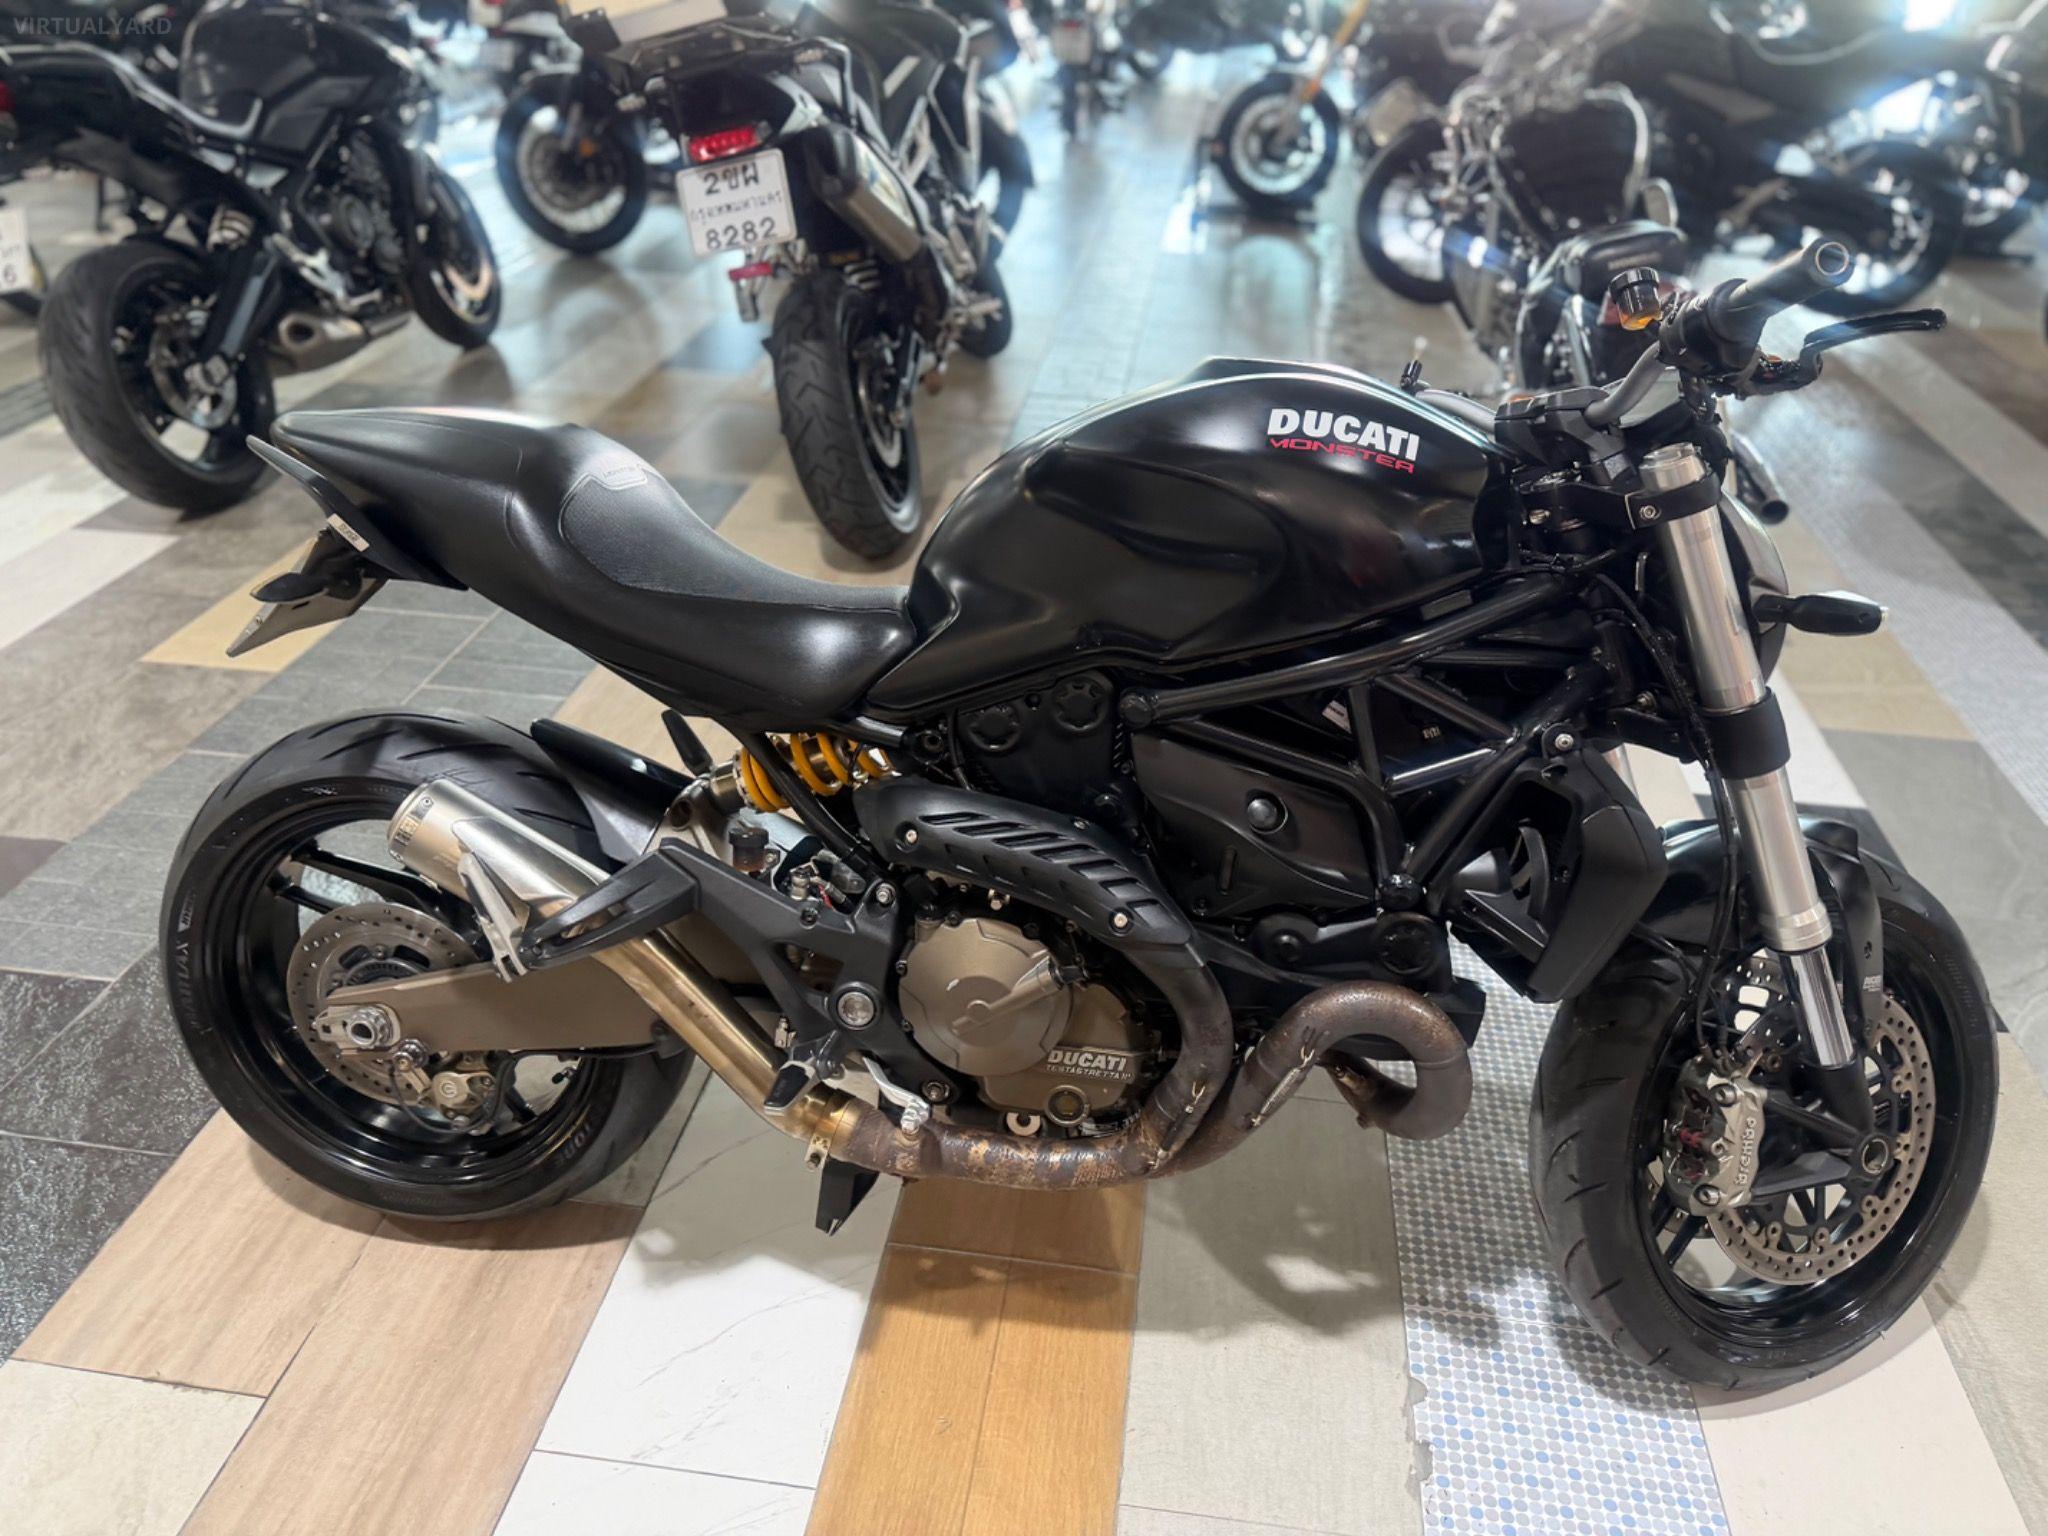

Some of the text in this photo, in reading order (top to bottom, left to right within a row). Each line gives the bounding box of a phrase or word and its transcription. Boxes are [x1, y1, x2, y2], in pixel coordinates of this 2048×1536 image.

[705, 216, 778, 250] 8282
[1267, 408, 1420, 461] DUCATI
[1269, 438, 1415, 474] MONSTER
[1047, 1050, 1127, 1071] DUCATI
[1734, 1117, 1757, 1185] brembo
